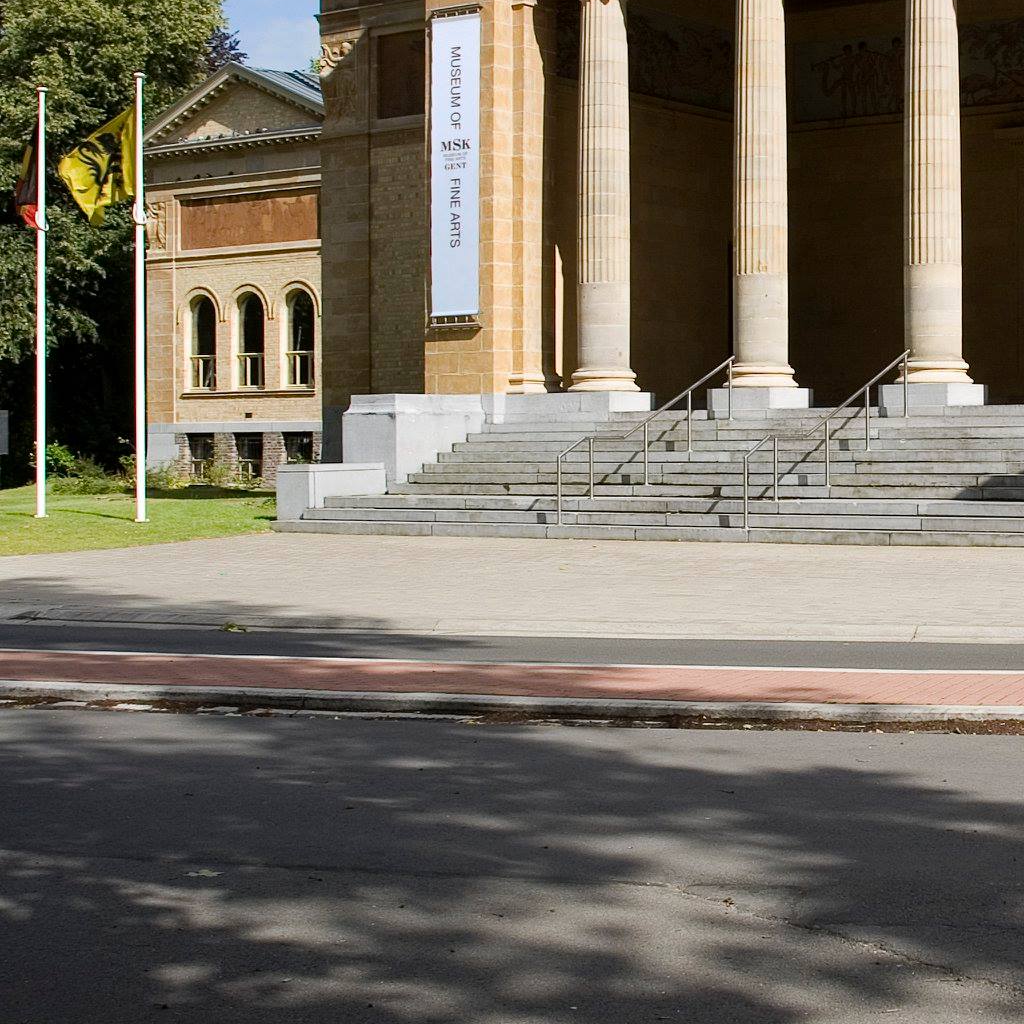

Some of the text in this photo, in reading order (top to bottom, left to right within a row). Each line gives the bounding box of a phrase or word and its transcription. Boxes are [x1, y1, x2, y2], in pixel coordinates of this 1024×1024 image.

[450, 46, 461, 130] MUSEUM OF
[441, 138, 471, 152] MSK
[444, 162, 467, 171] GENT
[449, 178, 461, 248] FINE ARTS
